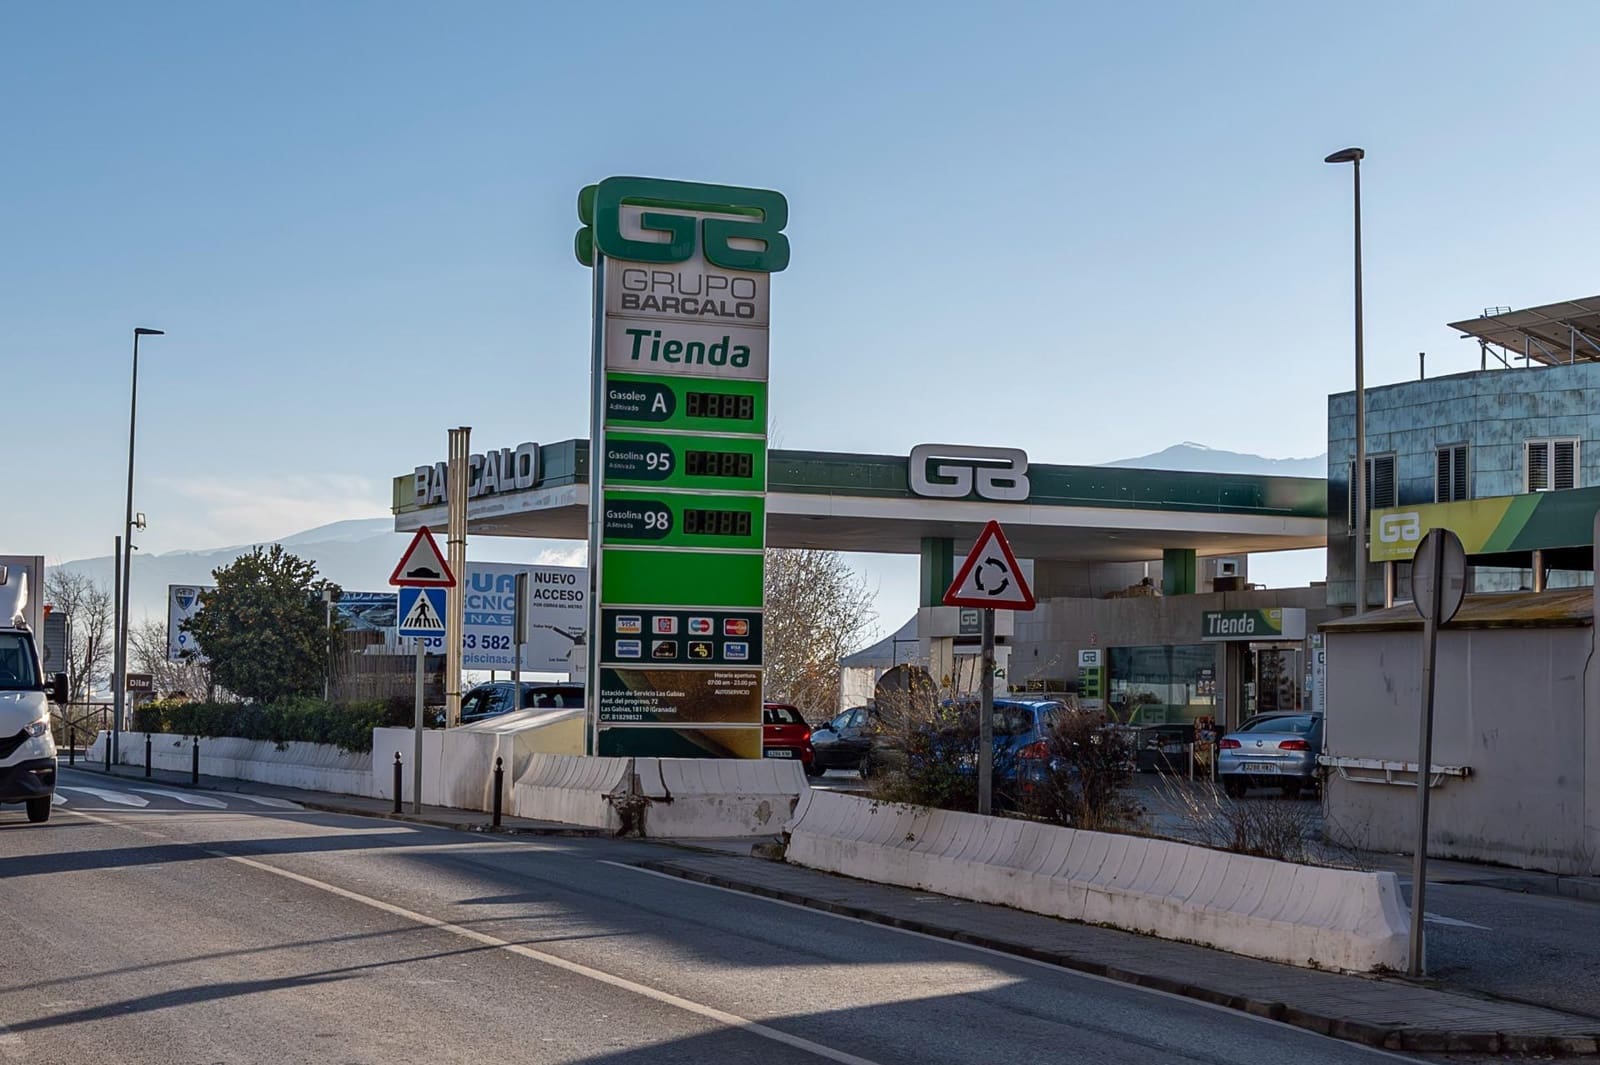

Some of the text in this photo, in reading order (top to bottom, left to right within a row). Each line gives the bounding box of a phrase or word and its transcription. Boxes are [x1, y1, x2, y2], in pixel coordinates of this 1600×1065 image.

[595, 176, 790, 273] GB
[622, 269, 757, 300] GRUPO
[621, 293, 756, 319] BARCALO
[625, 329, 752, 369] Tienda
[609, 390, 668, 413] Gasoleo A
[608, 450, 671, 471] Gasolina 95
[908, 443, 1031, 500] GB
[414, 442, 540, 506] BACALO
[606, 510, 669, 530] Gasolina 98
[1379, 512, 1420, 543] GB
[534, 572, 577, 585] NUEVO
[533, 588, 585, 602] ACCESO
[1207, 612, 1255, 634] Tienda
[481, 635, 510, 650] 582
[130, 679, 150, 687] Dilar
